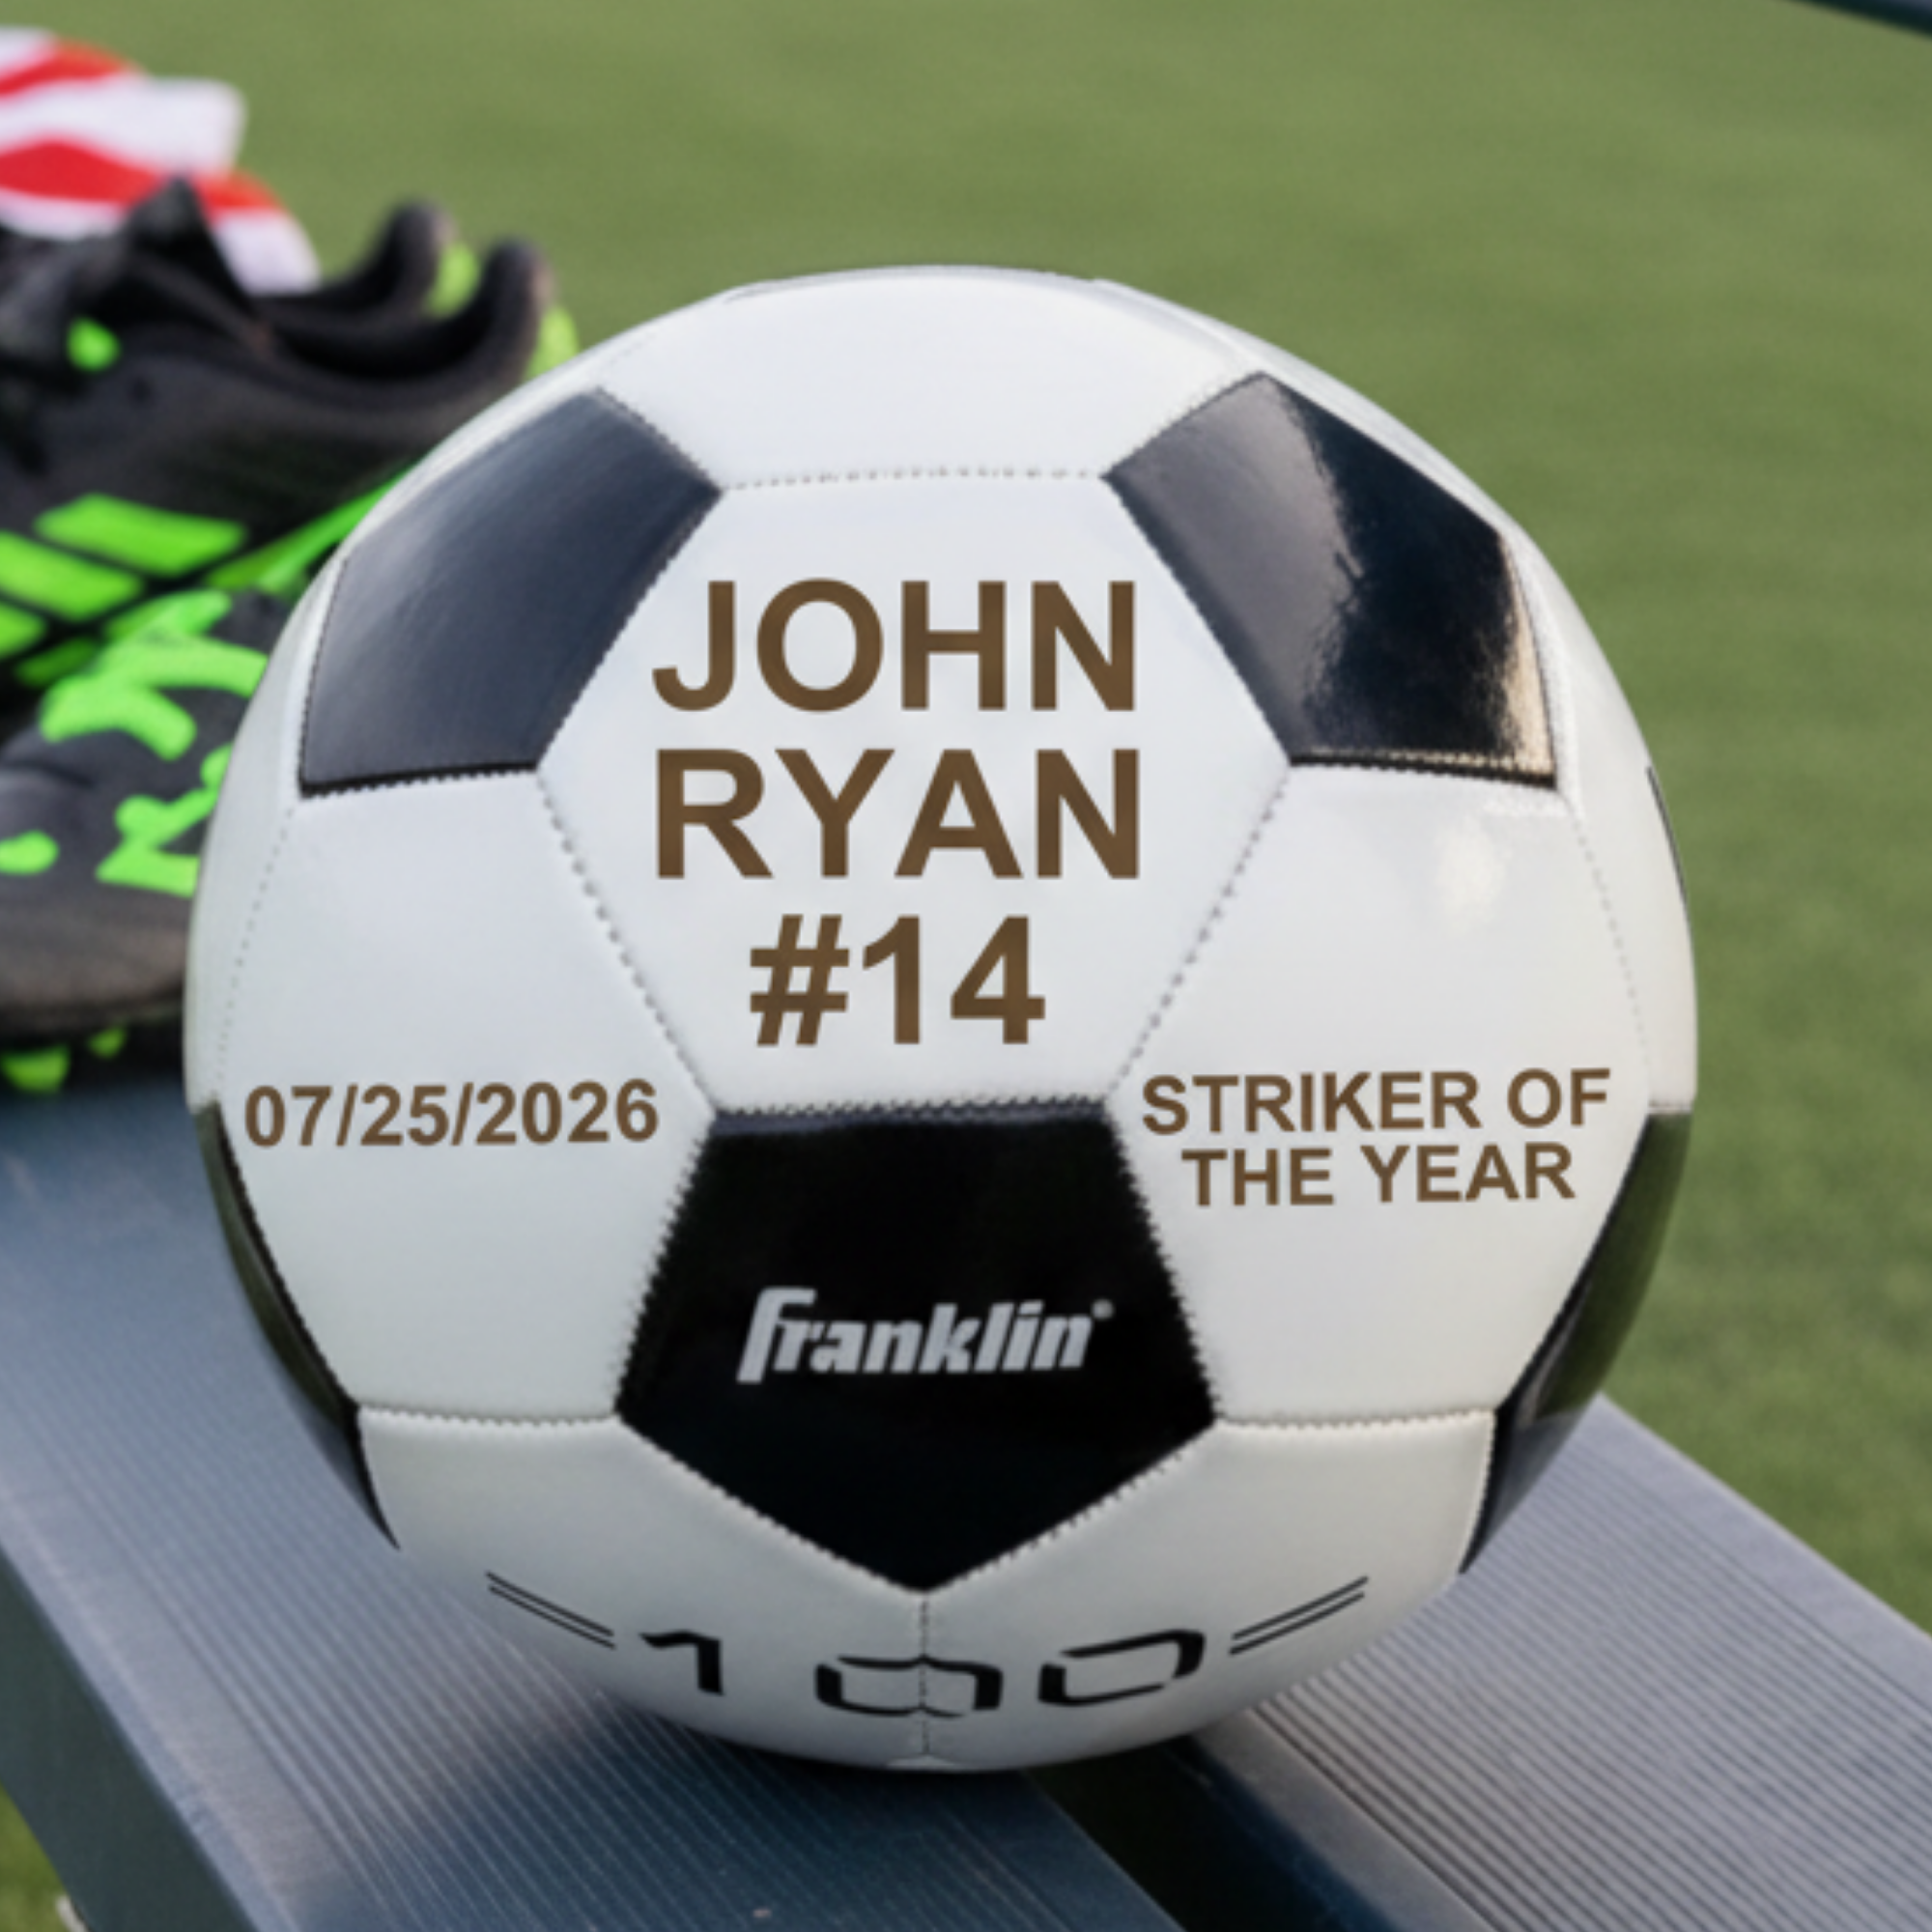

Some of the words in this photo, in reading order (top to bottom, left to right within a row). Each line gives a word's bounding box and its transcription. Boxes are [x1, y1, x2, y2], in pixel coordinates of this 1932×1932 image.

[652, 578, 1135, 713] JOHN
[657, 749, 1140, 879] RYAN
[750, 914, 1046, 1046] #14
[243, 1079, 660, 1150] 07/25/2026
[1142, 1071, 1482, 1136] STRIKER
[1507, 1066, 1611, 1129] OF
[1179, 1147, 1335, 1208] THE
[1359, 1141, 1577, 1204] YEAR
